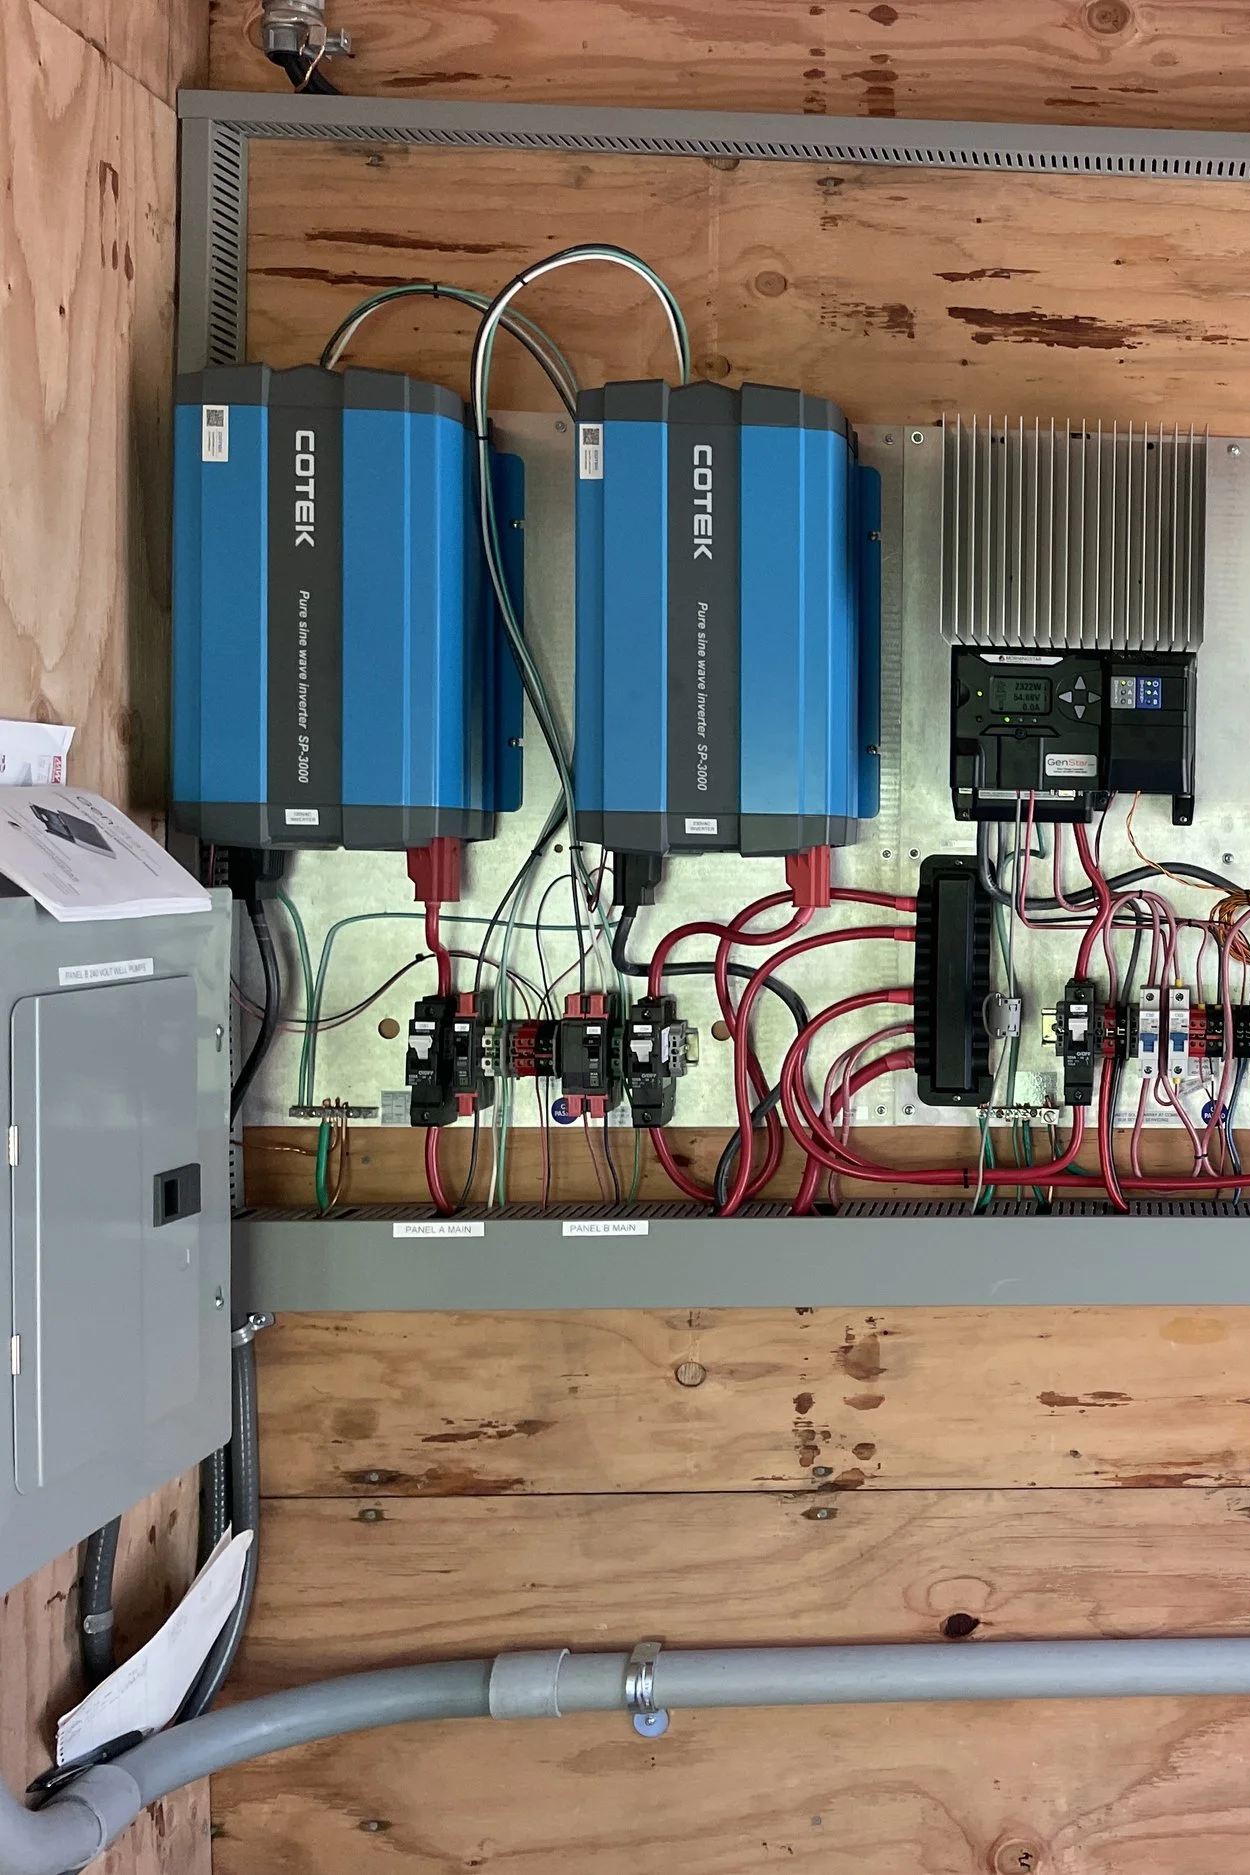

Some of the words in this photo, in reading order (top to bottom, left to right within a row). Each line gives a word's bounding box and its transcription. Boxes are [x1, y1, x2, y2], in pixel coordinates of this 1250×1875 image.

[295, 430, 315, 547] COTEK
[693, 444, 713, 560] COTEK
[299, 589, 310, 618] Pure
[697, 602, 708, 629] Pure
[299, 621, 309, 646] sine
[697, 631, 707, 656] sine
[299, 648, 309, 677] wave
[697, 659, 708, 688] wave
[298, 680, 309, 730] inverter
[697, 690, 707, 739] inverter
[298, 735, 310, 784] SP-3000
[697, 743, 708, 792] SP-3000
[1047, 758, 1088, 766] GenStar
[65, 971, 84, 980] PANEL
[100, 967, 112, 977] VOLT
[405, 1226, 437, 1234] PANEL
